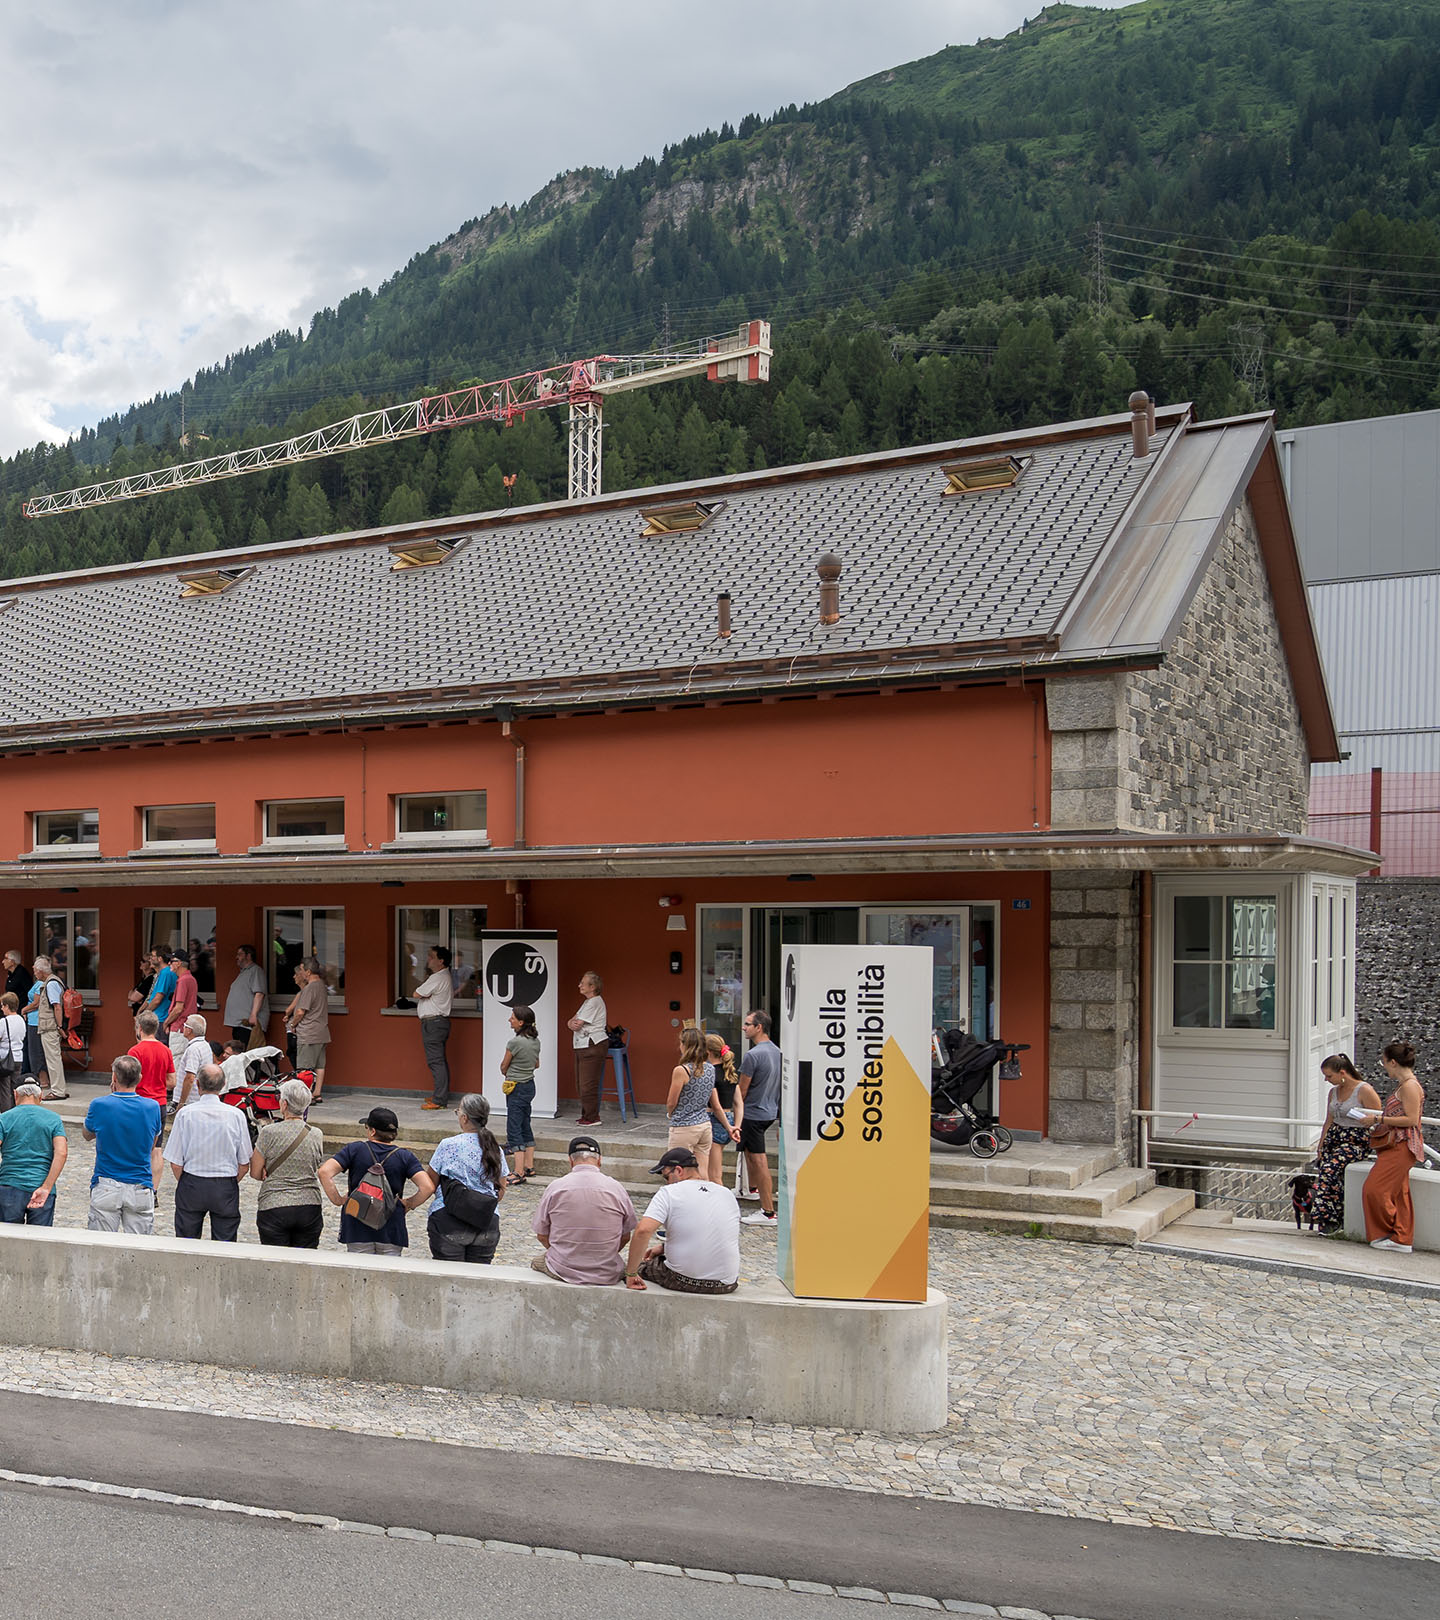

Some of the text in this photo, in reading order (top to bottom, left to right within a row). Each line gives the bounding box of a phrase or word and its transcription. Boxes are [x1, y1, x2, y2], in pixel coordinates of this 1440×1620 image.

[816, 988, 847, 1142] Casa della
[857, 964, 885, 1143] sostenibilità
